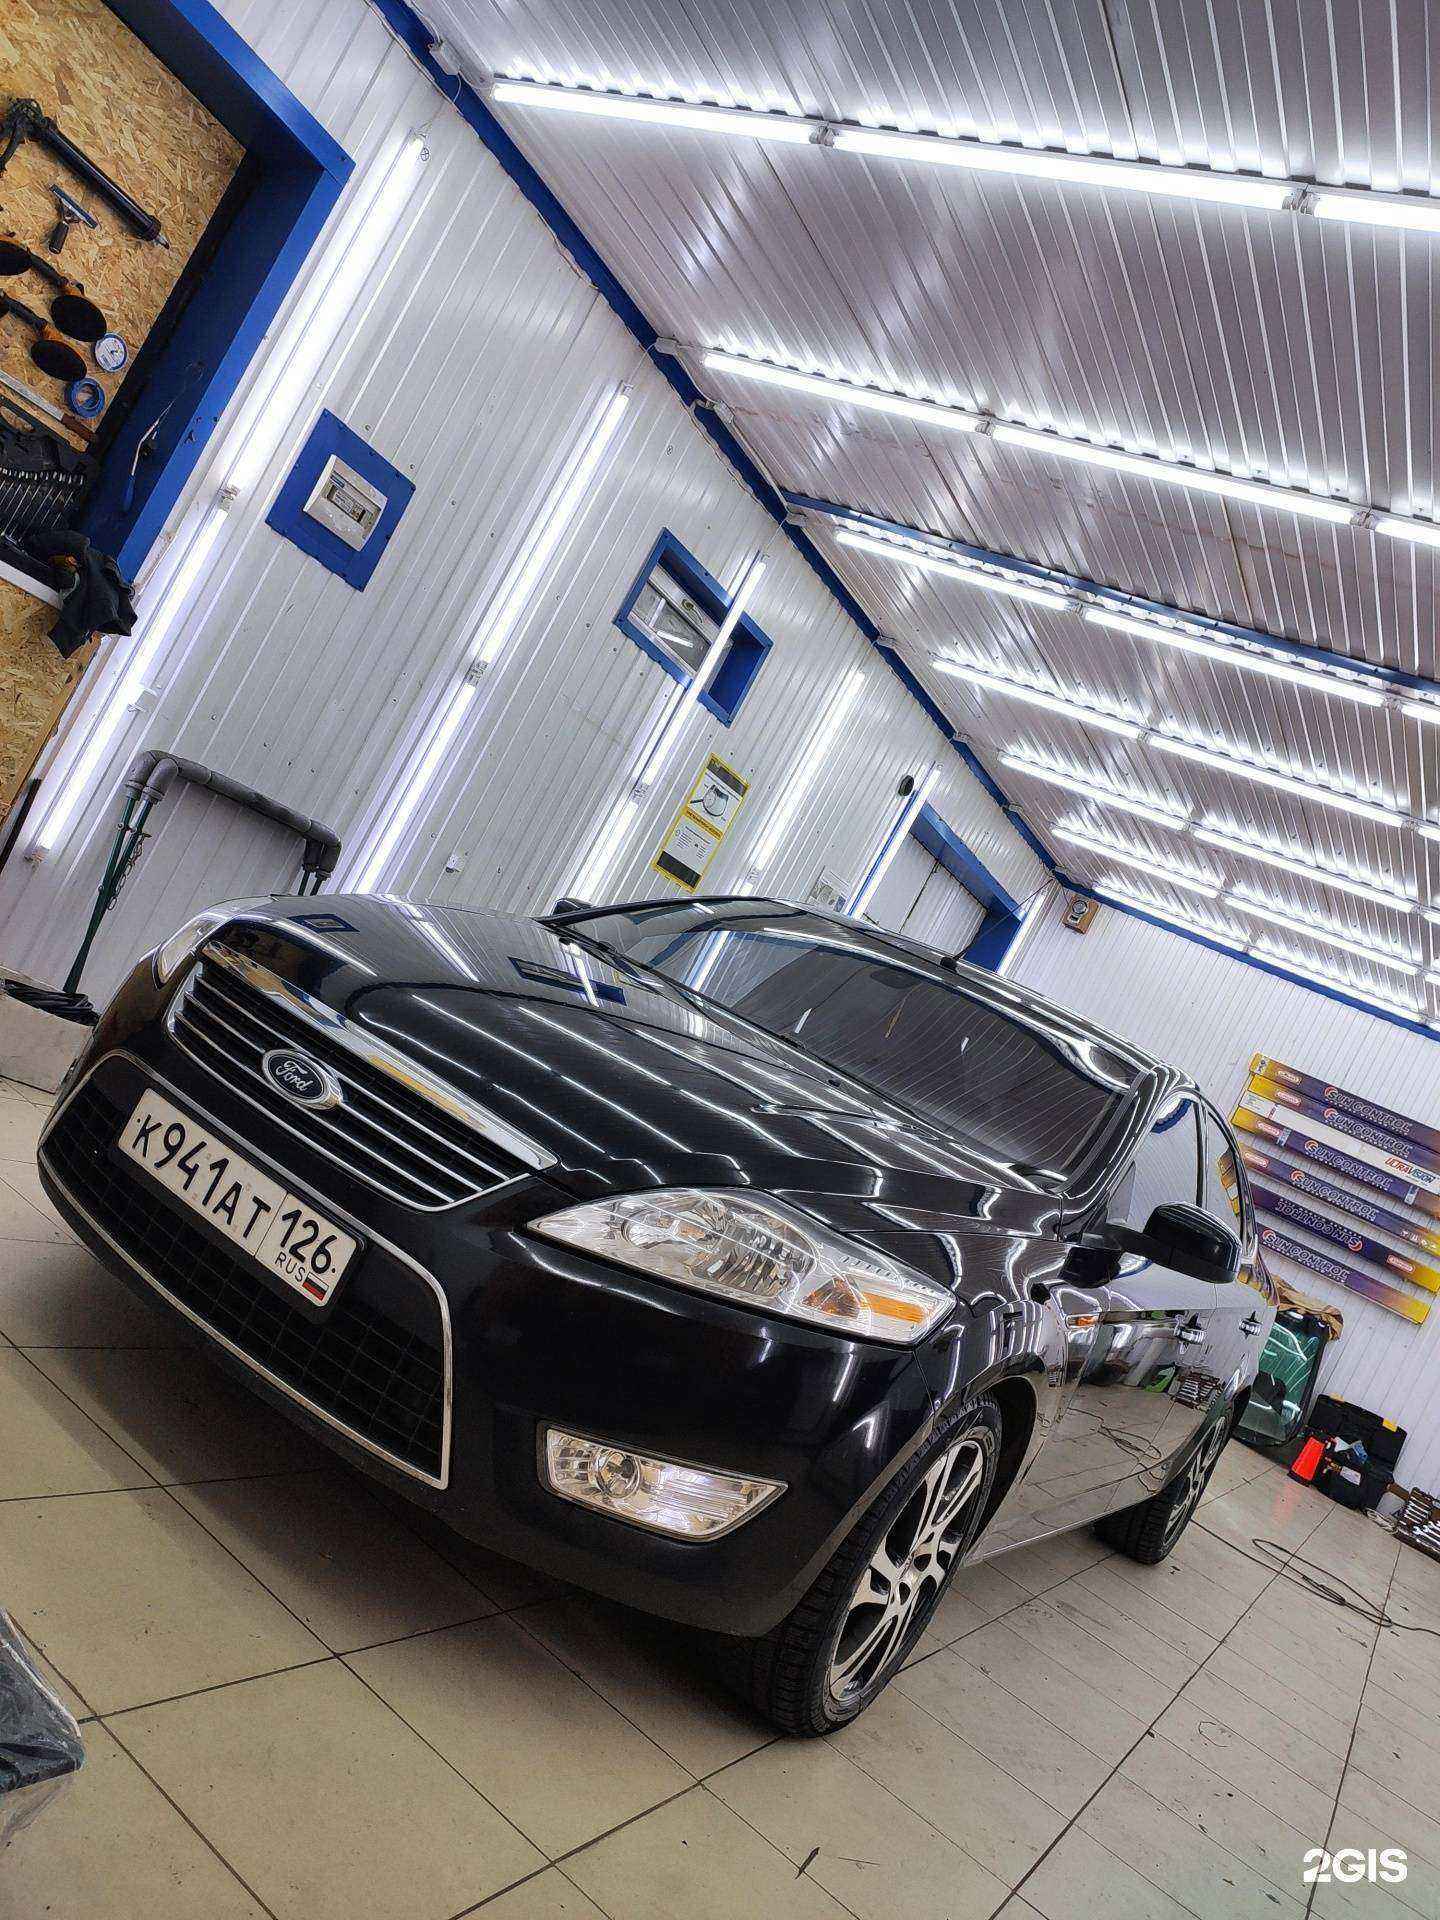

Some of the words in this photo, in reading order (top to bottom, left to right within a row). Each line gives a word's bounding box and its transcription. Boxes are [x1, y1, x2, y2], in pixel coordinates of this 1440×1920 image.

[276, 1060, 314, 1092] Ford
[282, 1209, 337, 1274] 126
[275, 1251, 306, 1282] RUS
